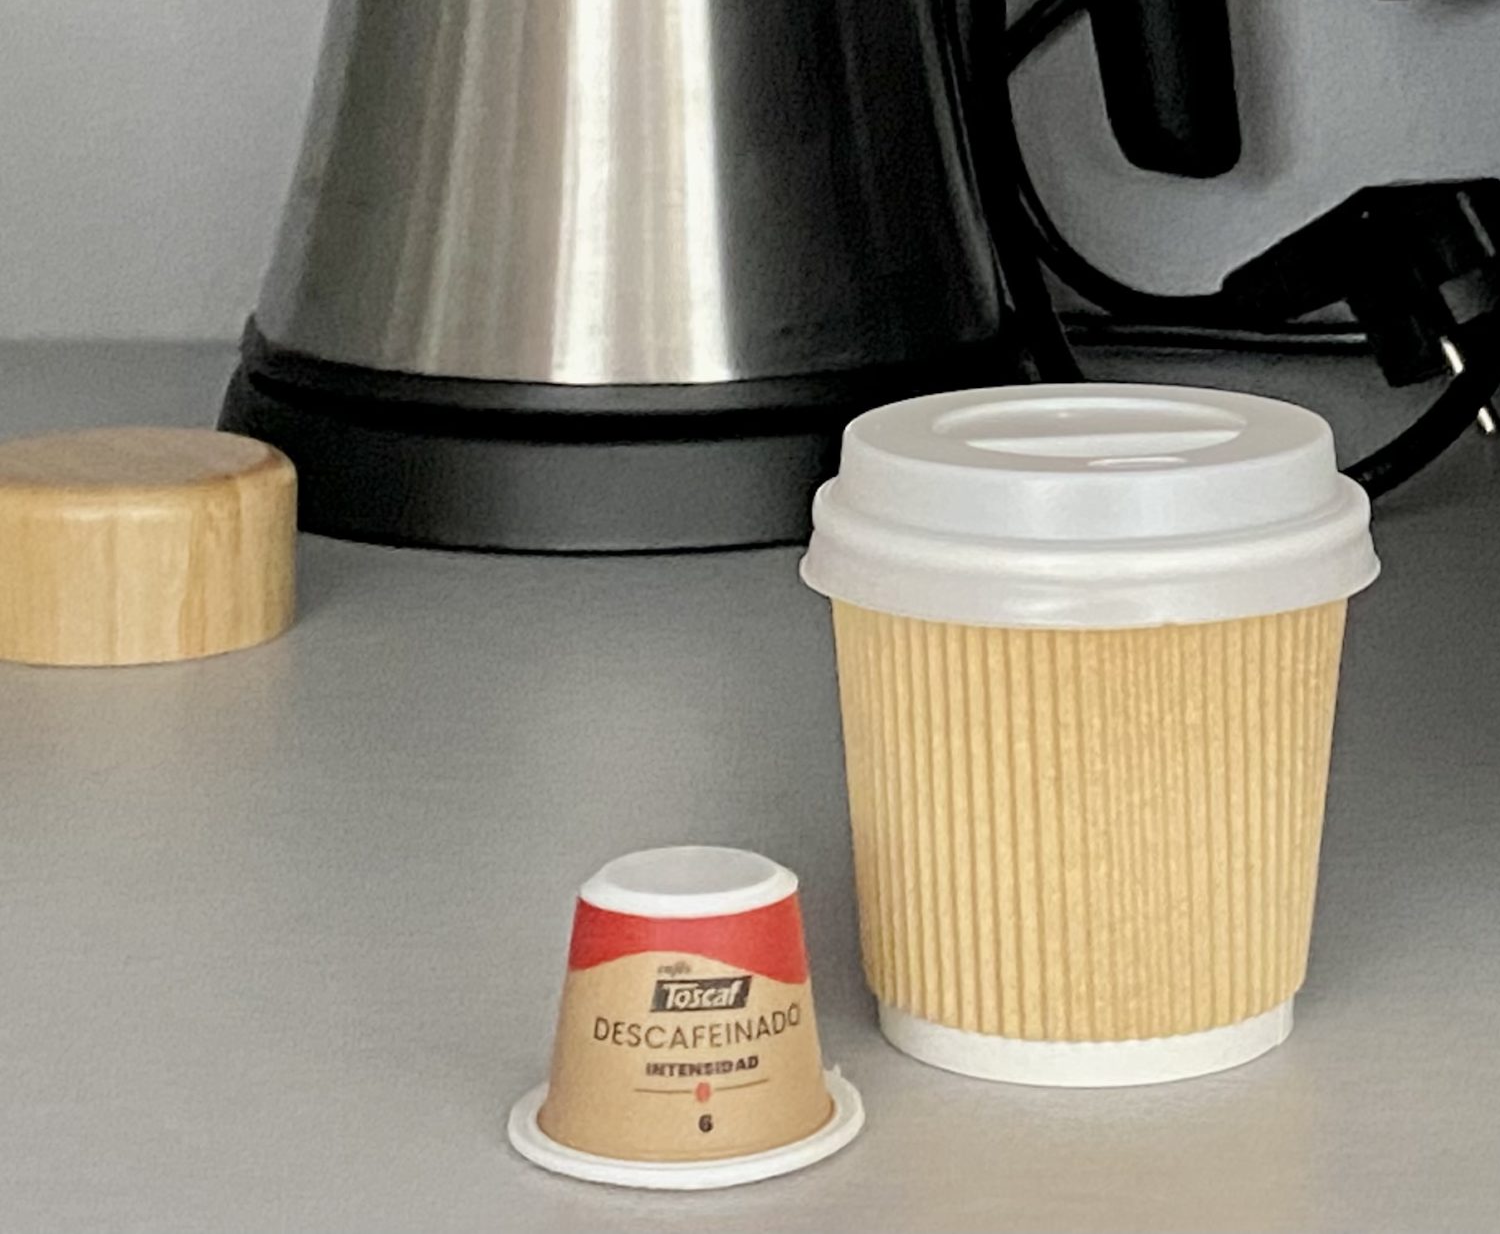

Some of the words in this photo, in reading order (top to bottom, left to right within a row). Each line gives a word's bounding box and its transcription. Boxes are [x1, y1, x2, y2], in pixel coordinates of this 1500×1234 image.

[593, 1002, 801, 1050] DESCAFEINADO
[646, 1055, 759, 1077] INTENSIDAD
[698, 1114, 713, 1132] 6
